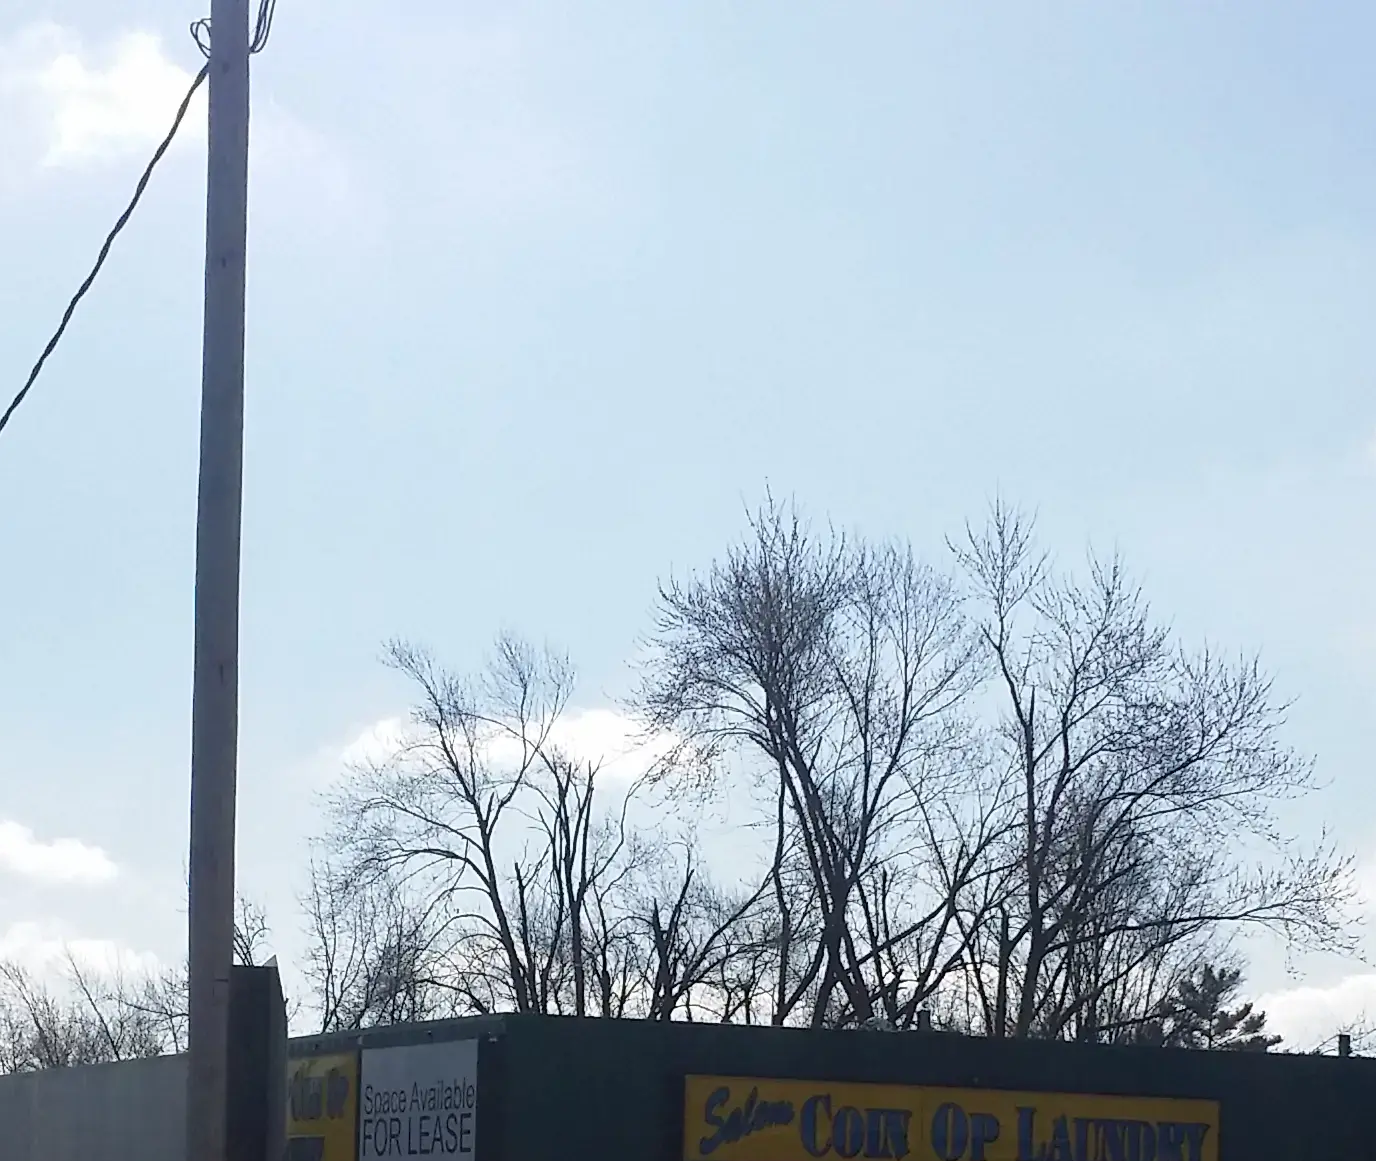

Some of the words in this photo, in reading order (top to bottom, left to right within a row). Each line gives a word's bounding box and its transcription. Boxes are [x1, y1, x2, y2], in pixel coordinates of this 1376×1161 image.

[364, 1084, 406, 1116] Space
[410, 1076, 475, 1111] Available
[363, 1118, 402, 1156] FOR
[408, 1113, 471, 1155] LEASE
[699, 1087, 795, 1155] Salem
